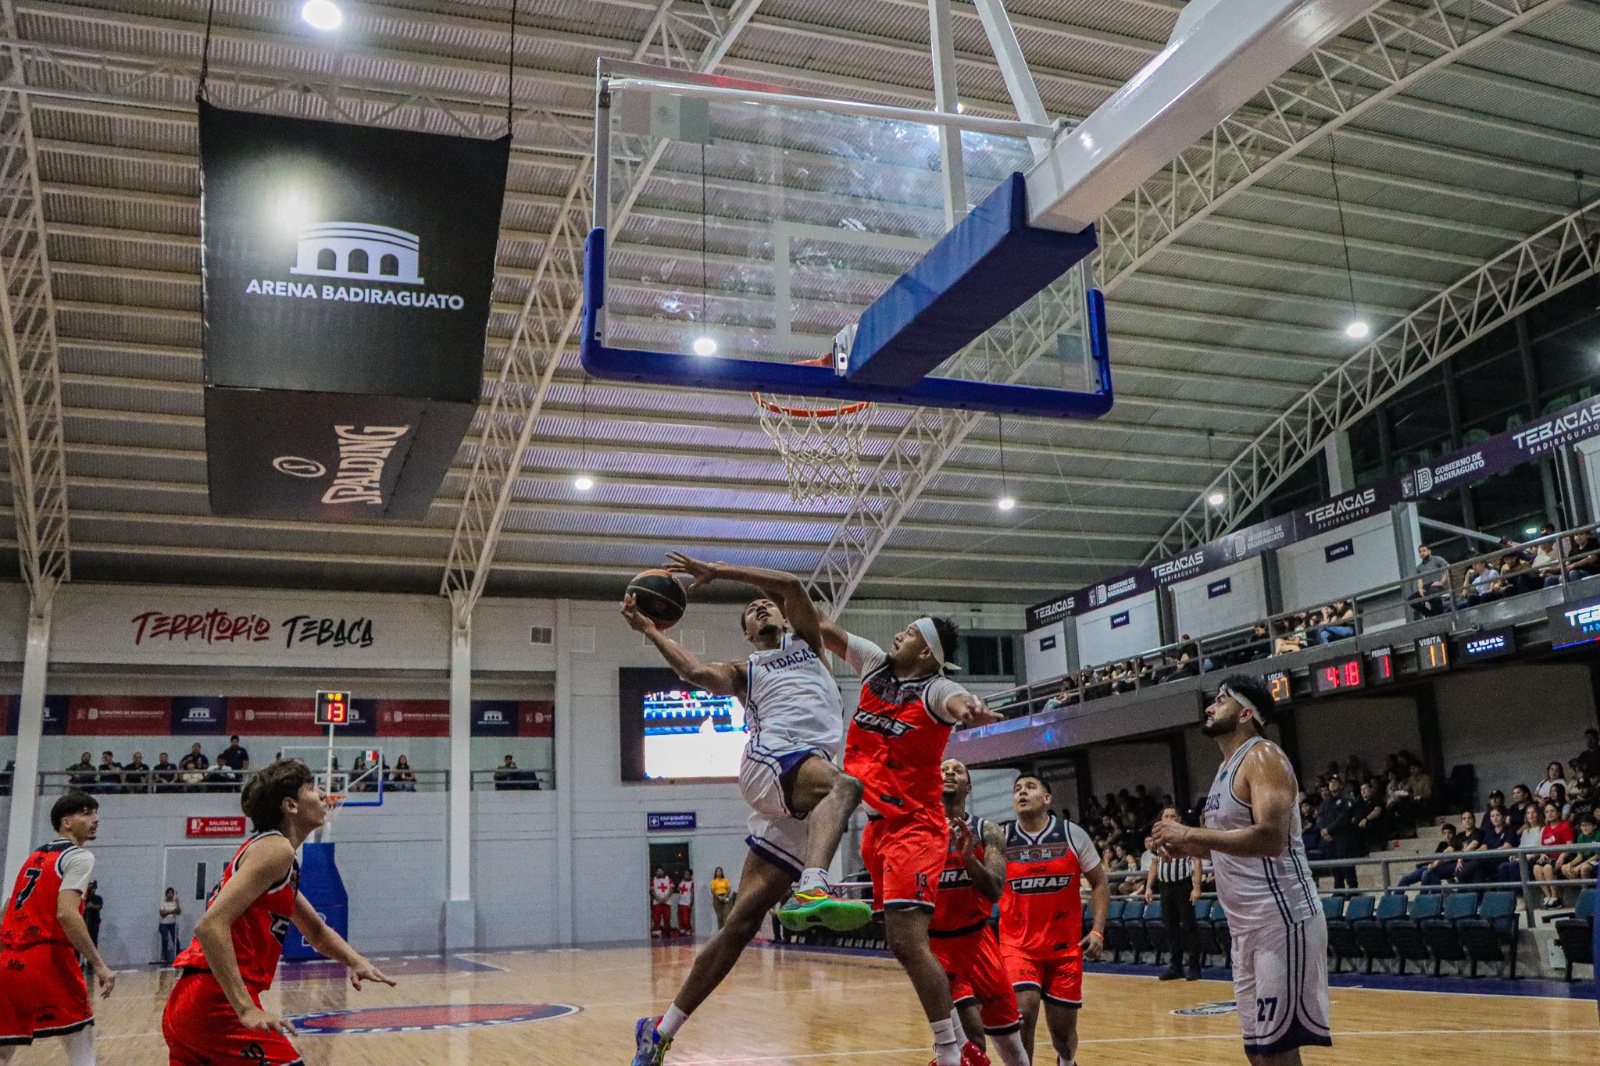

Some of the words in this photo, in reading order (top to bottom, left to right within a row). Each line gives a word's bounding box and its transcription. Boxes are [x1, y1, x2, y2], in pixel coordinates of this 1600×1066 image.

[245, 279, 317, 299] ARENA
[321, 285, 465, 311] BADIRAGUATO
[1512, 402, 1600, 449] TEBACAS
[1529, 423, 1599, 455] BADIRAGUATO
[321, 424, 411, 504] SPALDING
[1434, 456, 1471, 476] GOBIERNO
[1471, 451, 1482, 463] DE
[1434, 460, 1485, 484] BADIRAGUATO
[1305, 488, 1376, 524] TEBACAS
[1318, 507, 1370, 530] BADIRAGUATO
[1151, 551, 1204, 579] TEBACAS
[1034, 596, 1075, 620] TEBACAS
[281, 615, 375, 649] TEBACA
[1418, 635, 1442, 647] VISITA
[1371, 647, 1391, 658] PERIODO
[1429, 642, 1447, 667] 11
[1267, 672, 1285, 681] LOCAL
[1325, 660, 1360, 688] 4:18
[1383, 655, 1391, 677] 1
[1271, 676, 1290, 702] 27
[327, 702, 345, 722] 13
[854, 709, 907, 736] CORAS
[15, 867, 42, 911] 7
[915, 872, 928, 888] 13
[1011, 876, 1070, 890] CORAS
[1256, 996, 1278, 1022] 27
